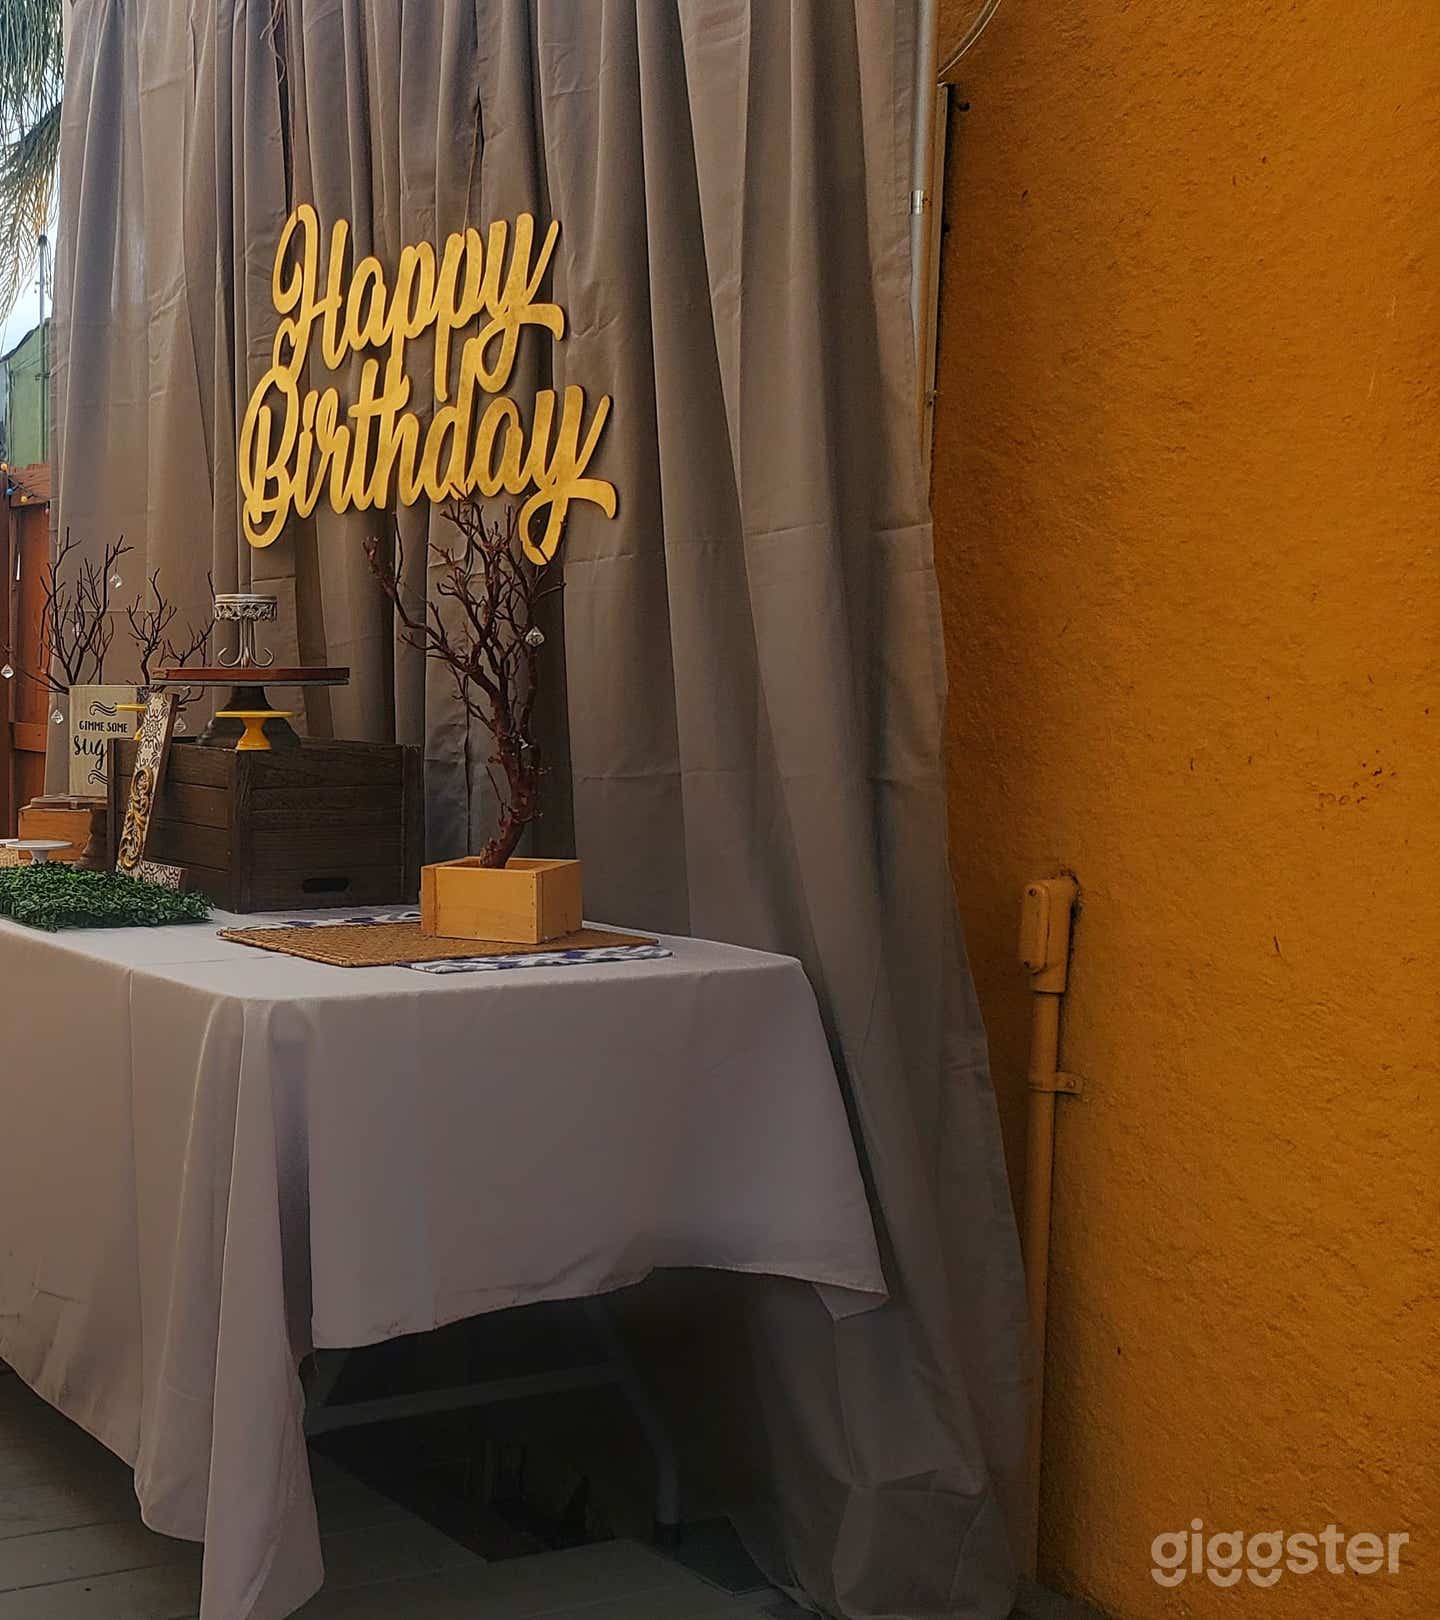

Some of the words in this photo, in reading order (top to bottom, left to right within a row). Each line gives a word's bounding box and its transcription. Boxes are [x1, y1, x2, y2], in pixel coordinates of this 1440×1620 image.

[272, 204, 564, 402] Happy
[239, 337, 617, 565] Birthday
[79, 720, 105, 732] GIMME
[106, 722, 128, 733] SOME
